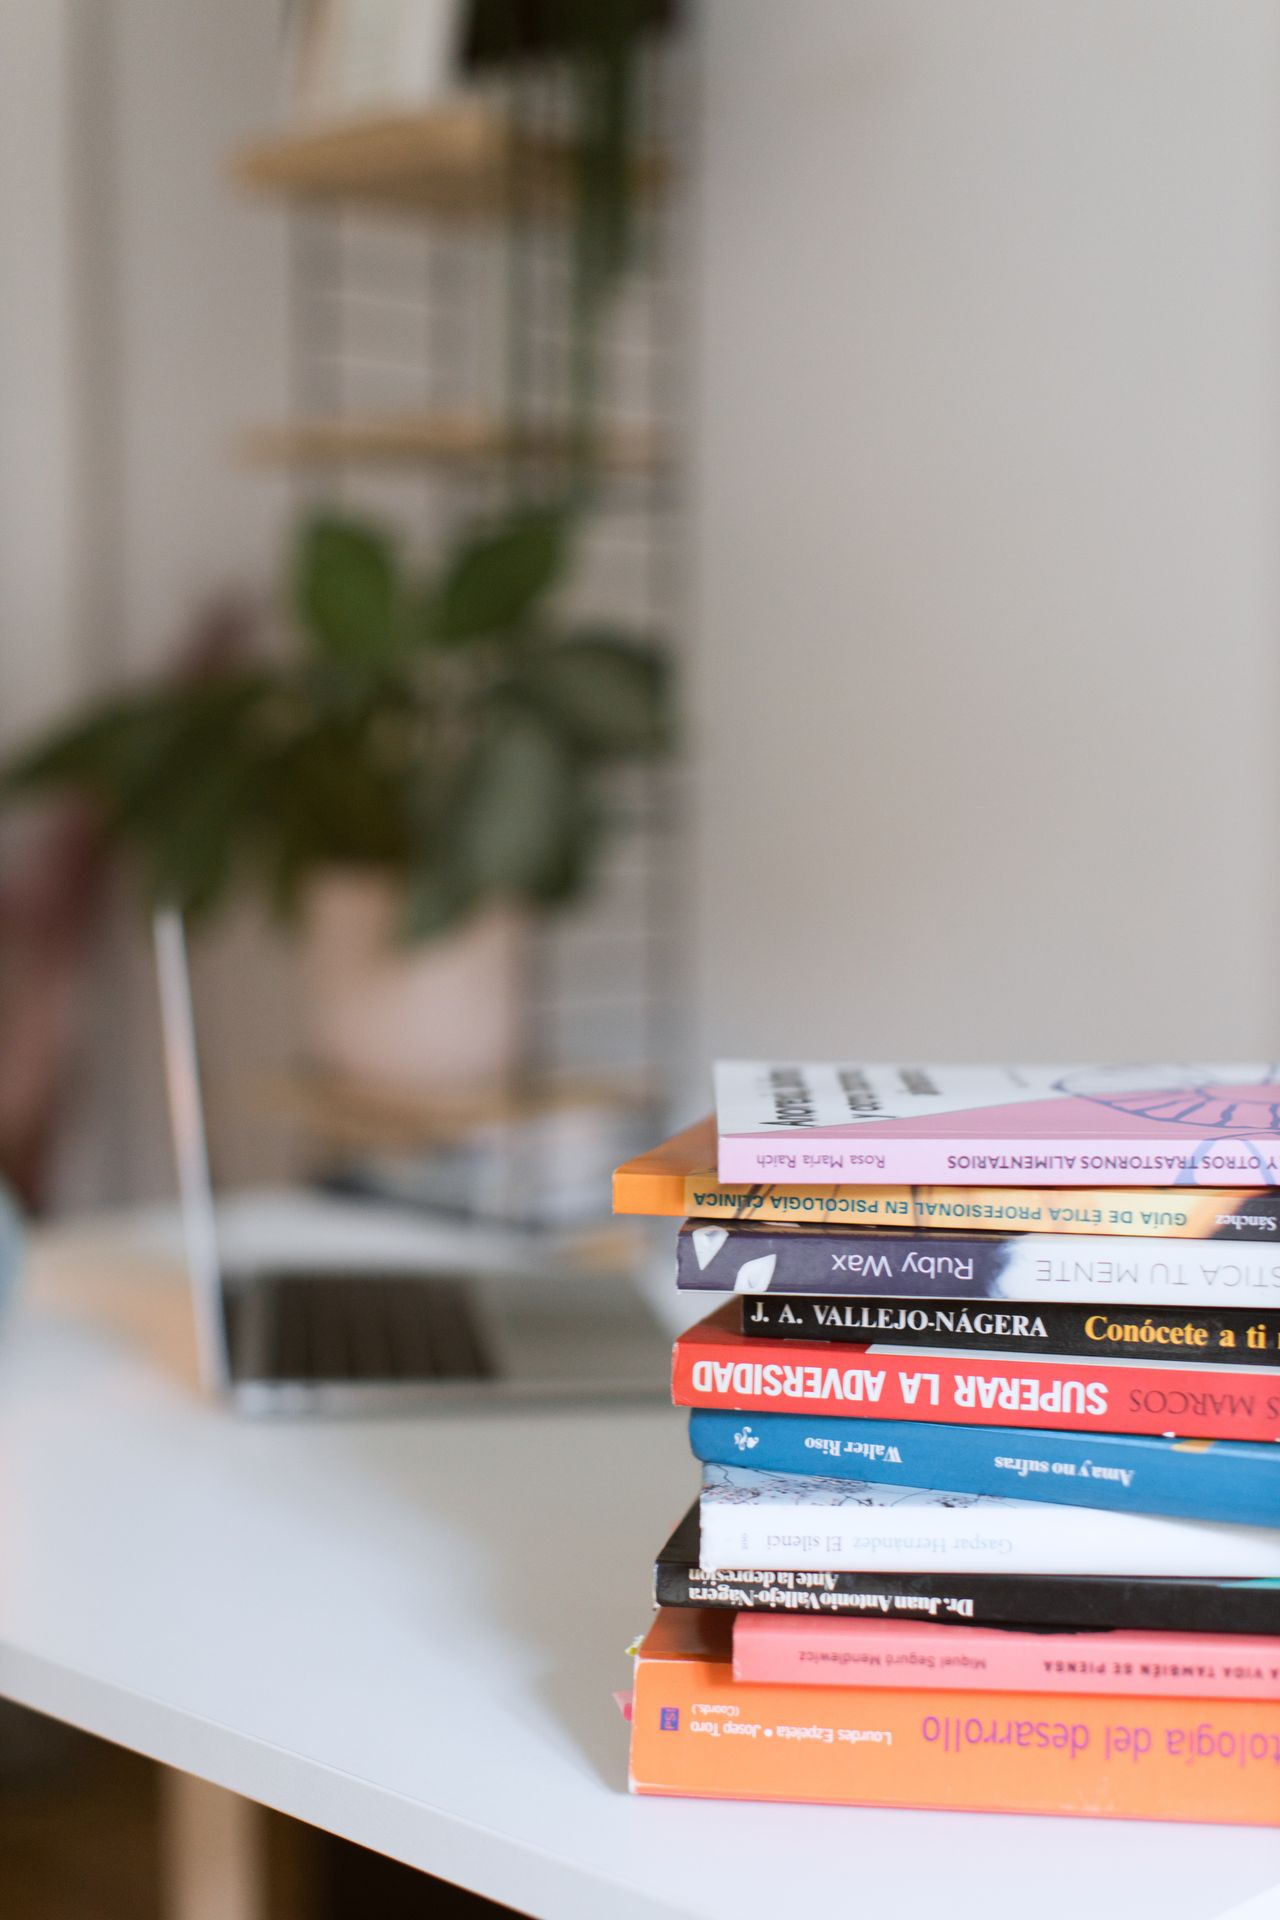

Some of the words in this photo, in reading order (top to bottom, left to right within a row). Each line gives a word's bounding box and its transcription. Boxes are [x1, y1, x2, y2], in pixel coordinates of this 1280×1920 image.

[756, 1154, 797, 1168] Raich
[802, 1154, 844, 1169] María
[849, 1154, 886, 1168] Rosa
[947, 1155, 1077, 1169] ALIMENTARIOS
[1081, 1155, 1198, 1169] TRASTORNOS
[1201, 1155, 1261, 1169] OTROS
[1266, 1155, 1277, 1169] Y
[693, 1192, 764, 1210] CLÍNICA
[770, 1195, 879, 1213] PSICOLOGÍA
[885, 1200, 909, 1215] EN
[914, 1202, 1042, 1221] PROFESIONAL
[1049, 1208, 1101, 1226] ÉTICA
[1109, 1210, 1133, 1224] DE
[1141, 1211, 1188, 1229] GUÍA
[1215, 1214, 1277, 1231] Sánchez
[831, 1254, 893, 1277] Wax
[900, 1252, 974, 1281] Ruby
[1035, 1260, 1138, 1284] MENTE
[1151, 1263, 1189, 1285] TU
[750, 1301, 769, 1321] J.
[778, 1304, 804, 1325] A.
[812, 1304, 1048, 1338] VALLEJO-NÁGERA
[1083, 1314, 1209, 1347] Conócete
[1218, 1328, 1237, 1348] a
[1246, 1323, 1268, 1350] ti
[692, 1361, 887, 1402] ADVERSIDAD
[898, 1372, 941, 1406] LA
[953, 1375, 1109, 1416] SUPERAR
[1128, 1388, 1255, 1417] MARCOS
[804, 1437, 842, 1456] Riso
[844, 1441, 903, 1464] Walter
[994, 1456, 1051, 1477] sufras
[1051, 1462, 1076, 1475] no
[1076, 1460, 1093, 1475] y
[1091, 1467, 1136, 1488] Ama
[766, 1535, 821, 1552] silenci
[824, 1535, 843, 1552] El
[953, 1533, 1013, 1554] Gaspar
[776, 1571, 795, 1590] la
[795, 1571, 839, 1591] Ante
[688, 1584, 822, 1610] Vallejo-Nágera
[820, 1592, 893, 1612] Antonio
[894, 1595, 942, 1615] Juan
[942, 1597, 975, 1617] Dr.
[1043, 1660, 1106, 1675] PIENSA
[1112, 1661, 1134, 1676] SE
[1139, 1663, 1216, 1680] TAMBIÉN
[1222, 1666, 1264, 1680] VIDA
[690, 1720, 721, 1738] Toro
[722, 1720, 762, 1739] Josep
[776, 1724, 834, 1744] Ezpeleta
[836, 1729, 893, 1746] Lourdes
[921, 1716, 1090, 1761] desarrollo
[1103, 1726, 1152, 1764] del
[1165, 1723, 1280, 1770] tología
